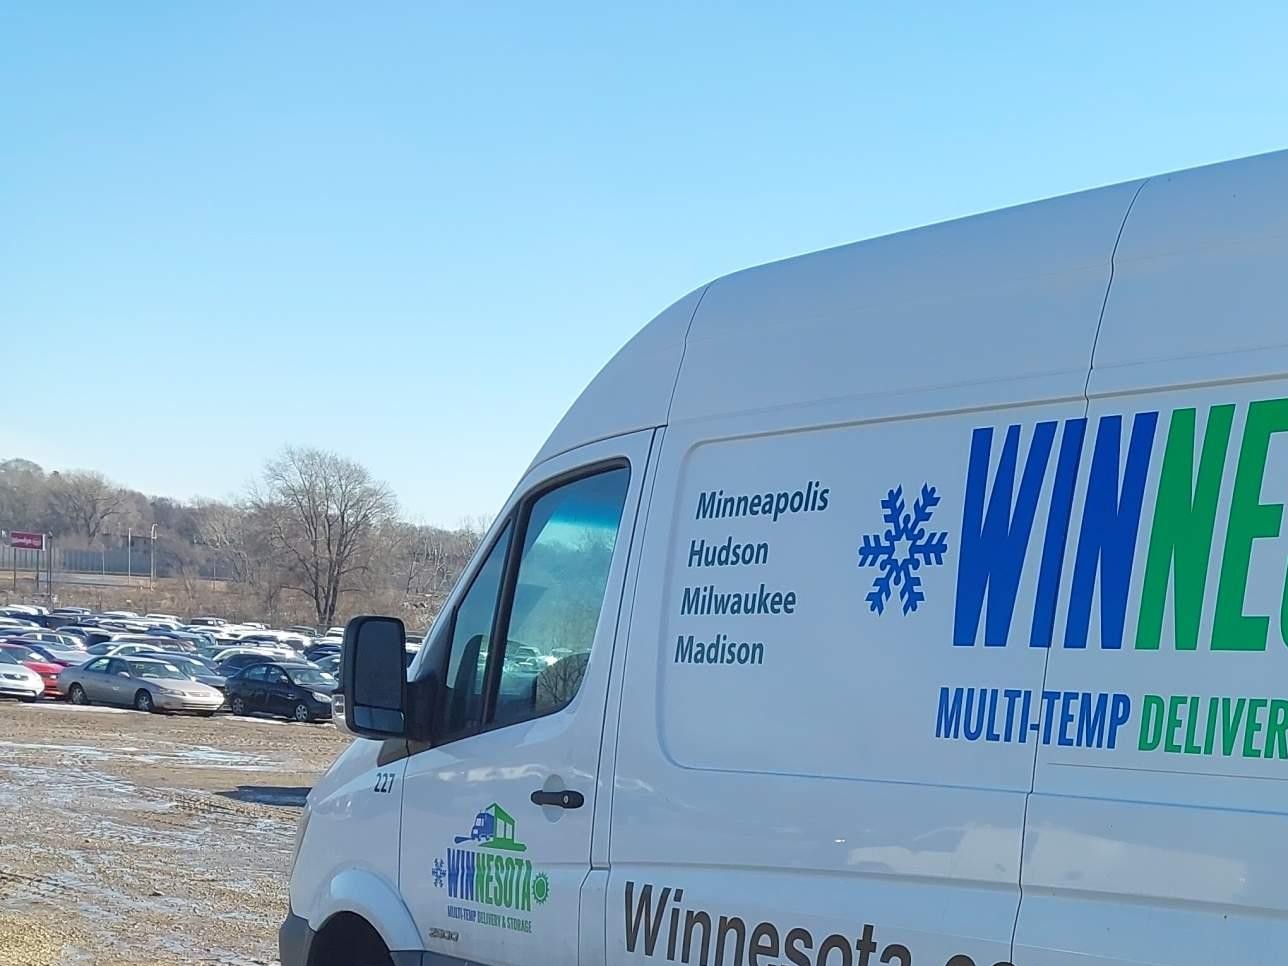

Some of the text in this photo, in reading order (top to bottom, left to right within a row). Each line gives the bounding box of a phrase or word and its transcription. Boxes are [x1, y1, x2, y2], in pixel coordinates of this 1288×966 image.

[695, 480, 830, 522] Minneapolis
[687, 536, 769, 567] Hudson
[680, 583, 796, 615] Milwaukee
[674, 634, 764, 664] Madison
[934, 686, 1132, 752] MULTI-TEMP
[373, 772, 396, 793] 227
[447, 847, 532, 912] WINNESOTA
[477, 911, 501, 928] DELIVERY
[506, 917, 532, 933] STORAGE
